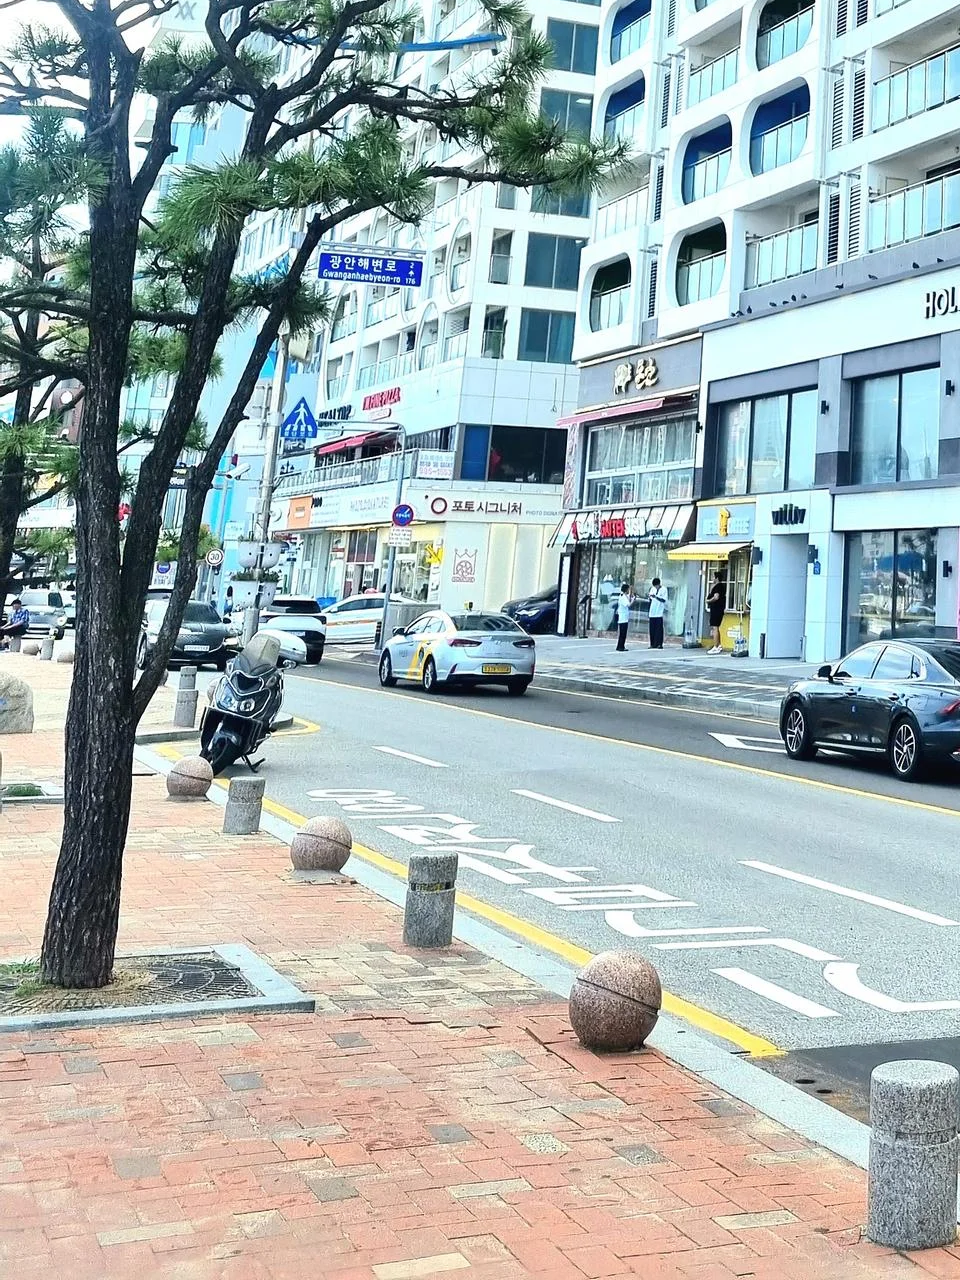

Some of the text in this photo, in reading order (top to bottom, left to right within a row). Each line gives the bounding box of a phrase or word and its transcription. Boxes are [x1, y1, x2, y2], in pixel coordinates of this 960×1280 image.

[329, 255, 397, 273] 광안해변로
[322, 269, 401, 283] Gwanganhaebyeon-ro
[451, 500, 523, 516] 포토 시그니처
[771, 503, 807, 526] villiv
[210, 553, 220, 561] 30
